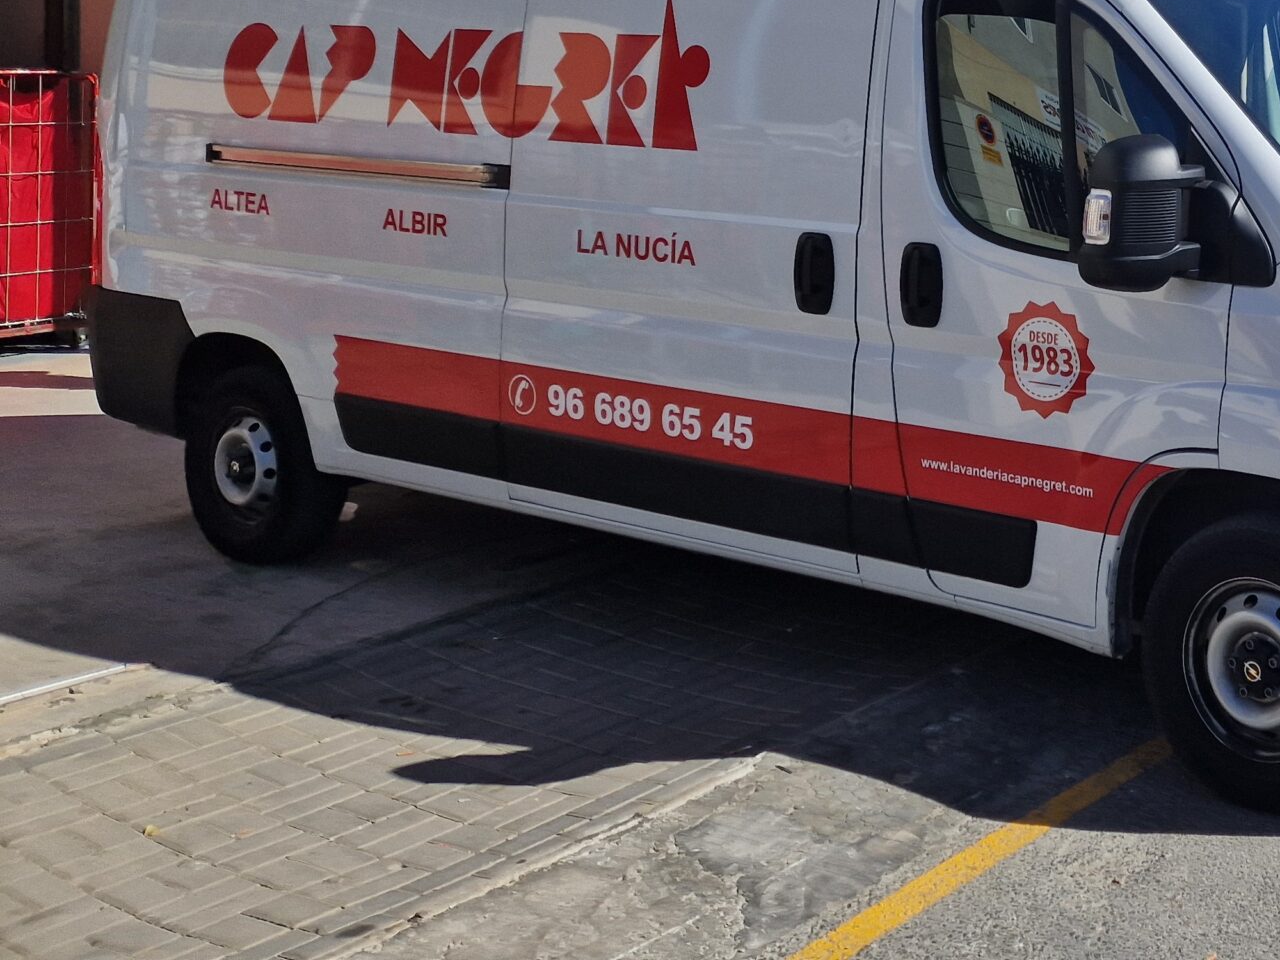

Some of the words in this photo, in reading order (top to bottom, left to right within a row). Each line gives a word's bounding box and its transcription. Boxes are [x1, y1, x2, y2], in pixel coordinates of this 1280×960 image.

[223, 22, 376, 123] CAP
[210, 188, 270, 216] ALTEA
[383, 208, 448, 237] ALBIR
[576, 229, 608, 257] LA
[615, 231, 696, 266] NUCÍA
[1018, 343, 1074, 377] 1983
[1029, 330, 1059, 346] DESDE
[548, 384, 584, 420] 96
[594, 392, 650, 432] 689
[661, 403, 701, 441] 65
[711, 412, 753, 450] 45
[921, 457, 1093, 498] www.lavanderiacapnegret.com
